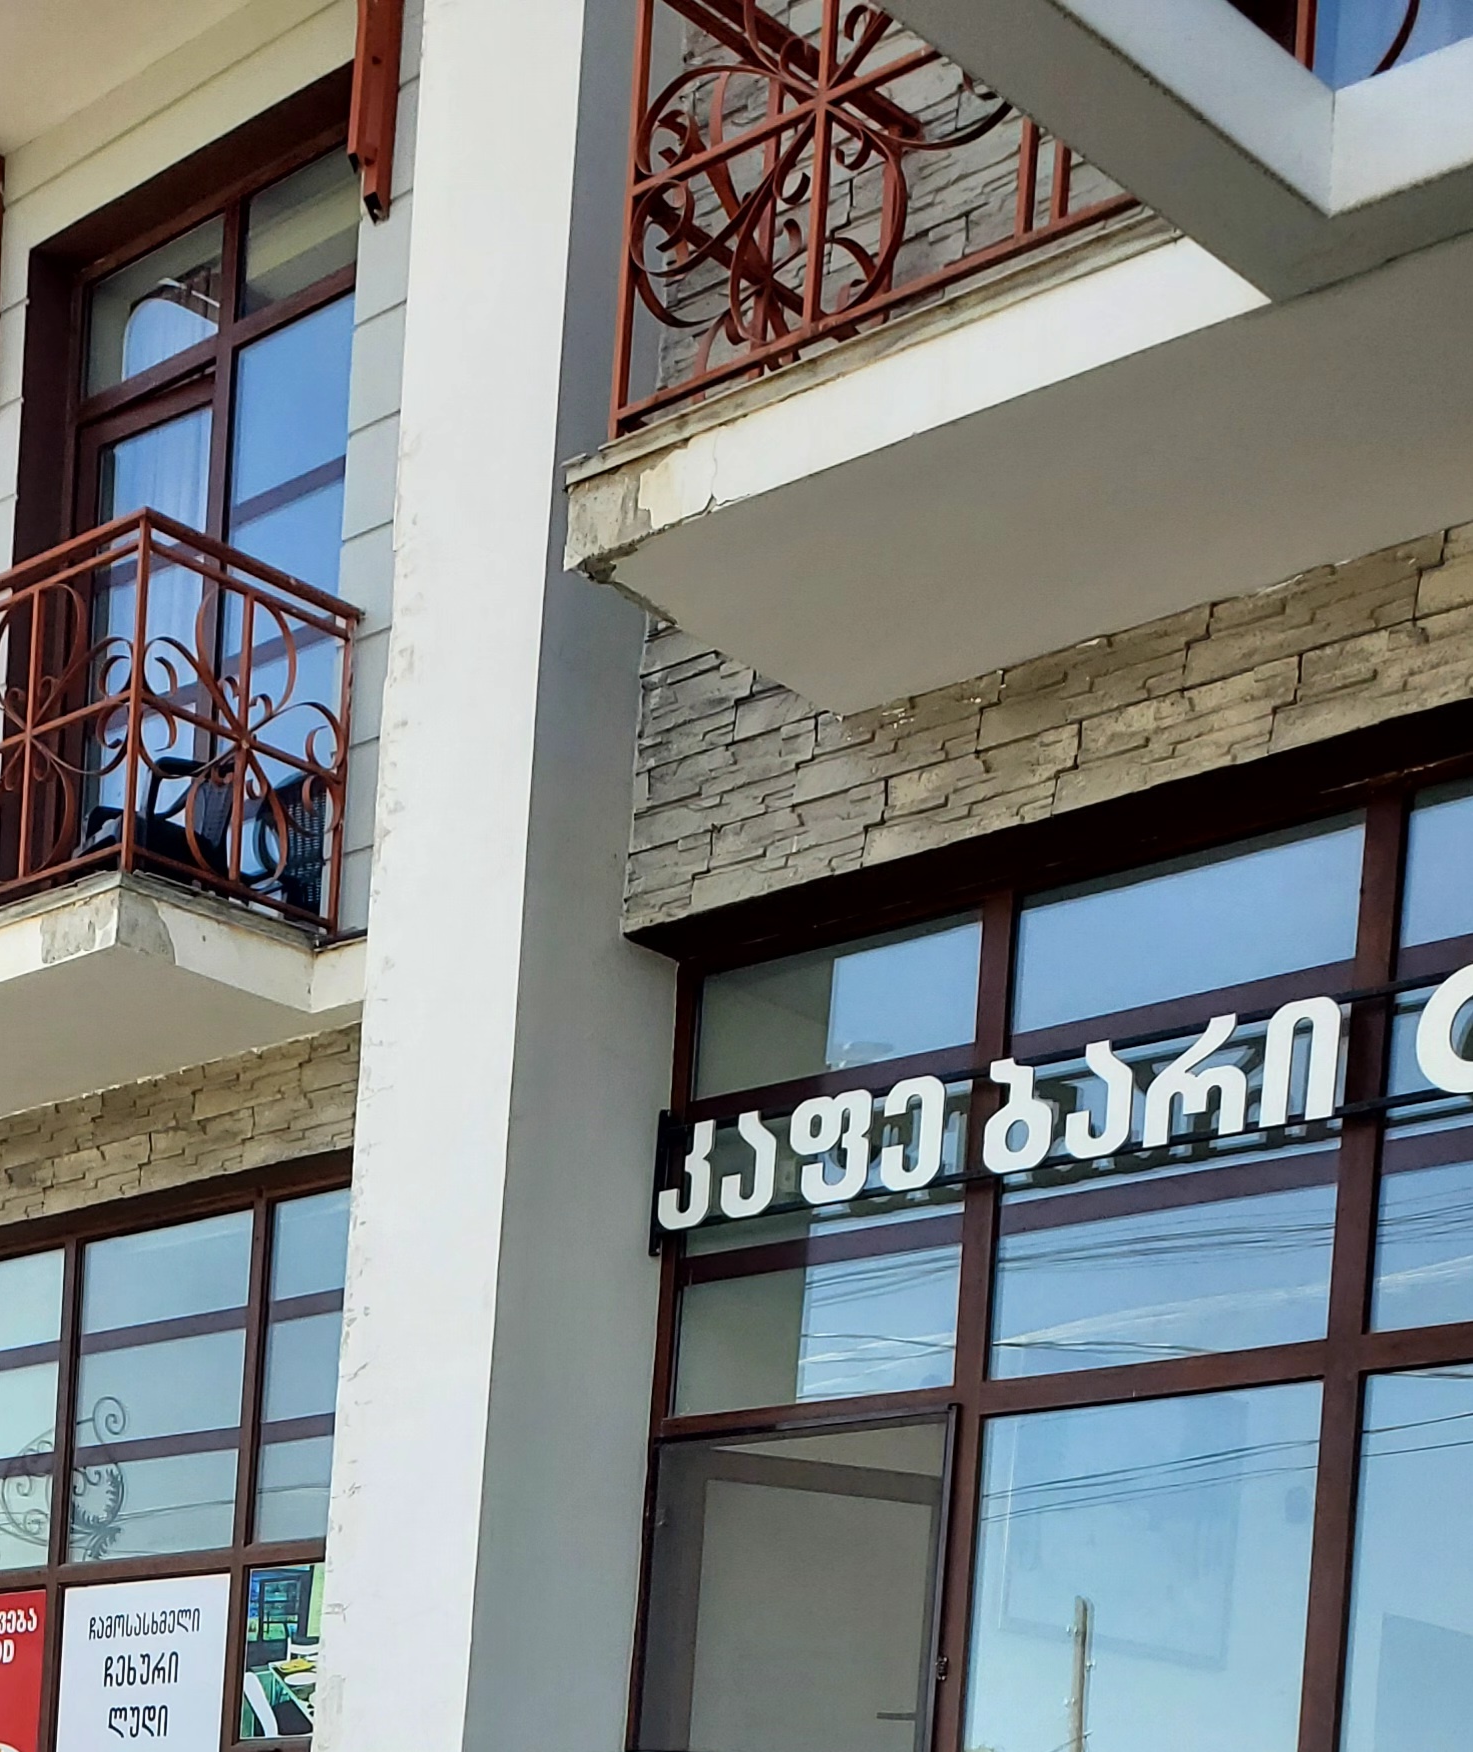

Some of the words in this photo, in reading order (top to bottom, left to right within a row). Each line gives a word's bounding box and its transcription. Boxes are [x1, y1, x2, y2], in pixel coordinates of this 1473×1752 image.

[658, 1075, 946, 1231] კაფე
[982, 995, 1343, 1175] ბარი
[88, 1607, 201, 1641] ჩამოსასხმელი
[103, 1650, 179, 1688] ჩეხური
[107, 1704, 169, 1739] ლუდი
